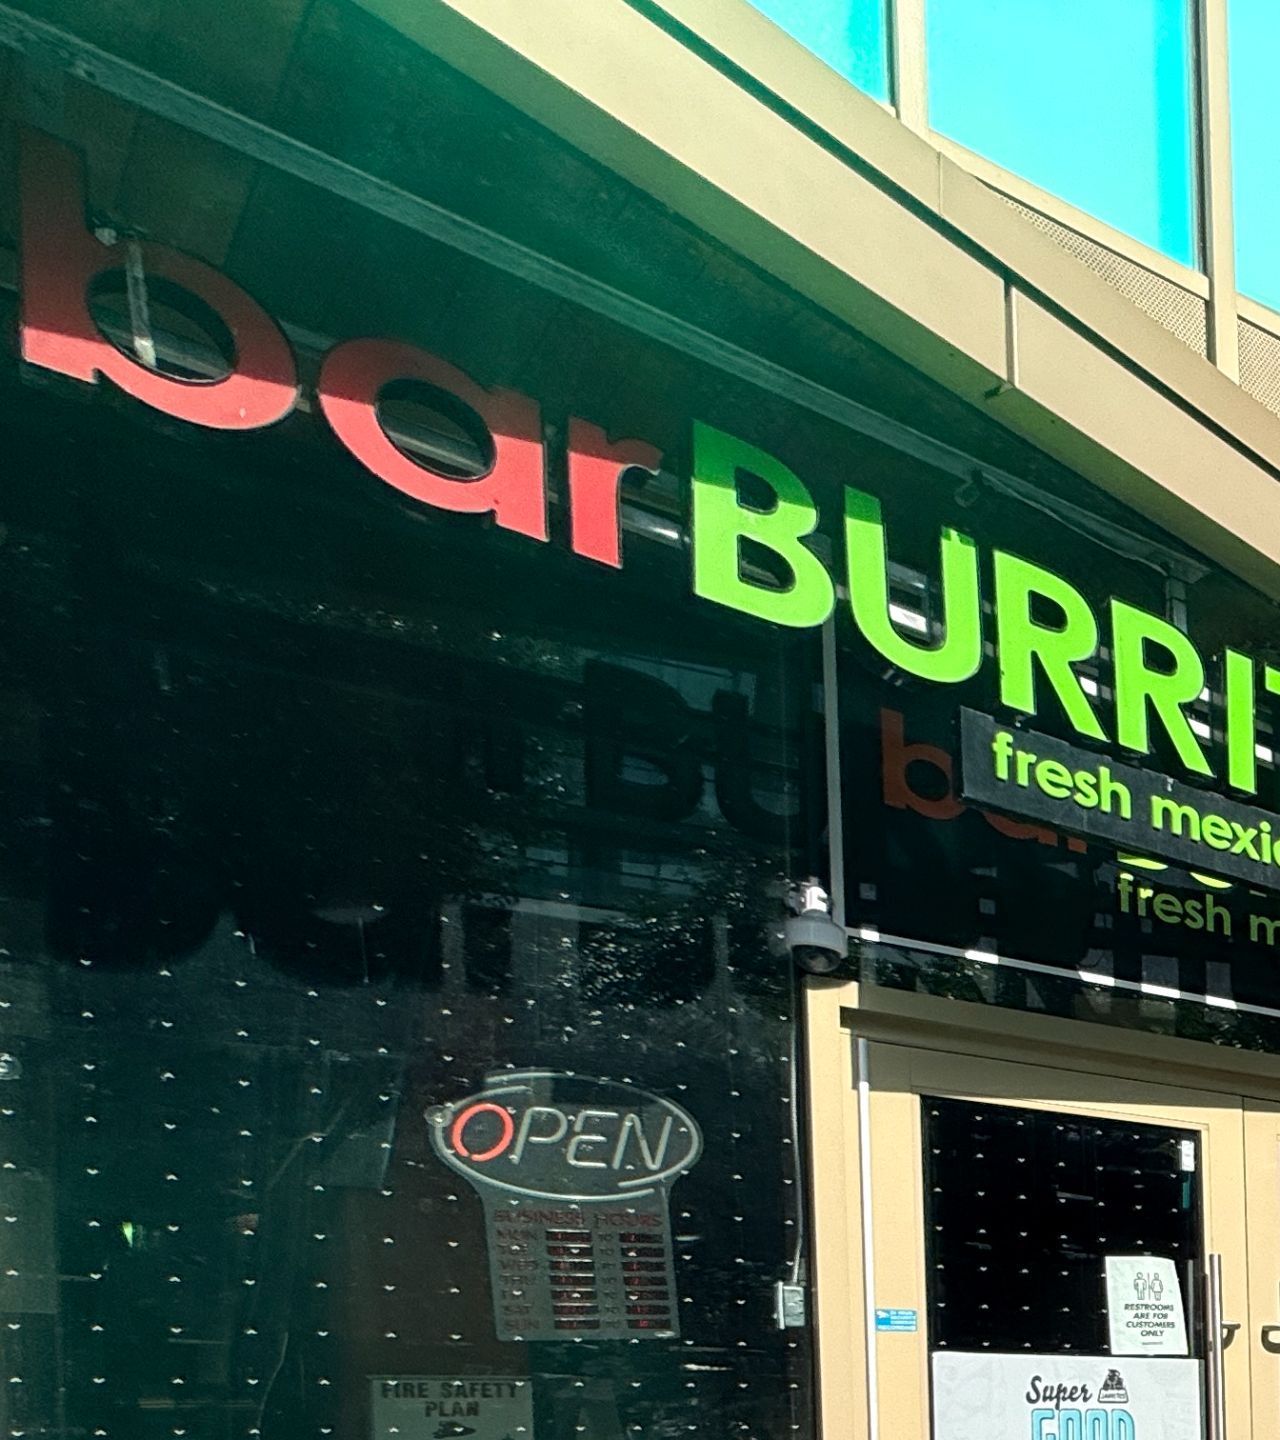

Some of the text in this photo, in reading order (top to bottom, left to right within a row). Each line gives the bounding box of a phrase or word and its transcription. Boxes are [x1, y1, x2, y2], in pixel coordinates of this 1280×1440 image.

[992, 732, 1132, 820] fresh
[1117, 871, 1231, 936] fresh
[451, 1102, 673, 1171] OPEN
[1124, 1303, 1174, 1312] RESTROOMS
[1133, 1312, 1169, 1320] ARE FOR
[1126, 1320, 1176, 1329] CUSTOMERS
[1140, 1329, 1165, 1337] ONLY
[382, 1382, 517, 1398] FIRE SAFETY
[1026, 1374, 1093, 1411] Super
[425, 1401, 480, 1417] PLAN
